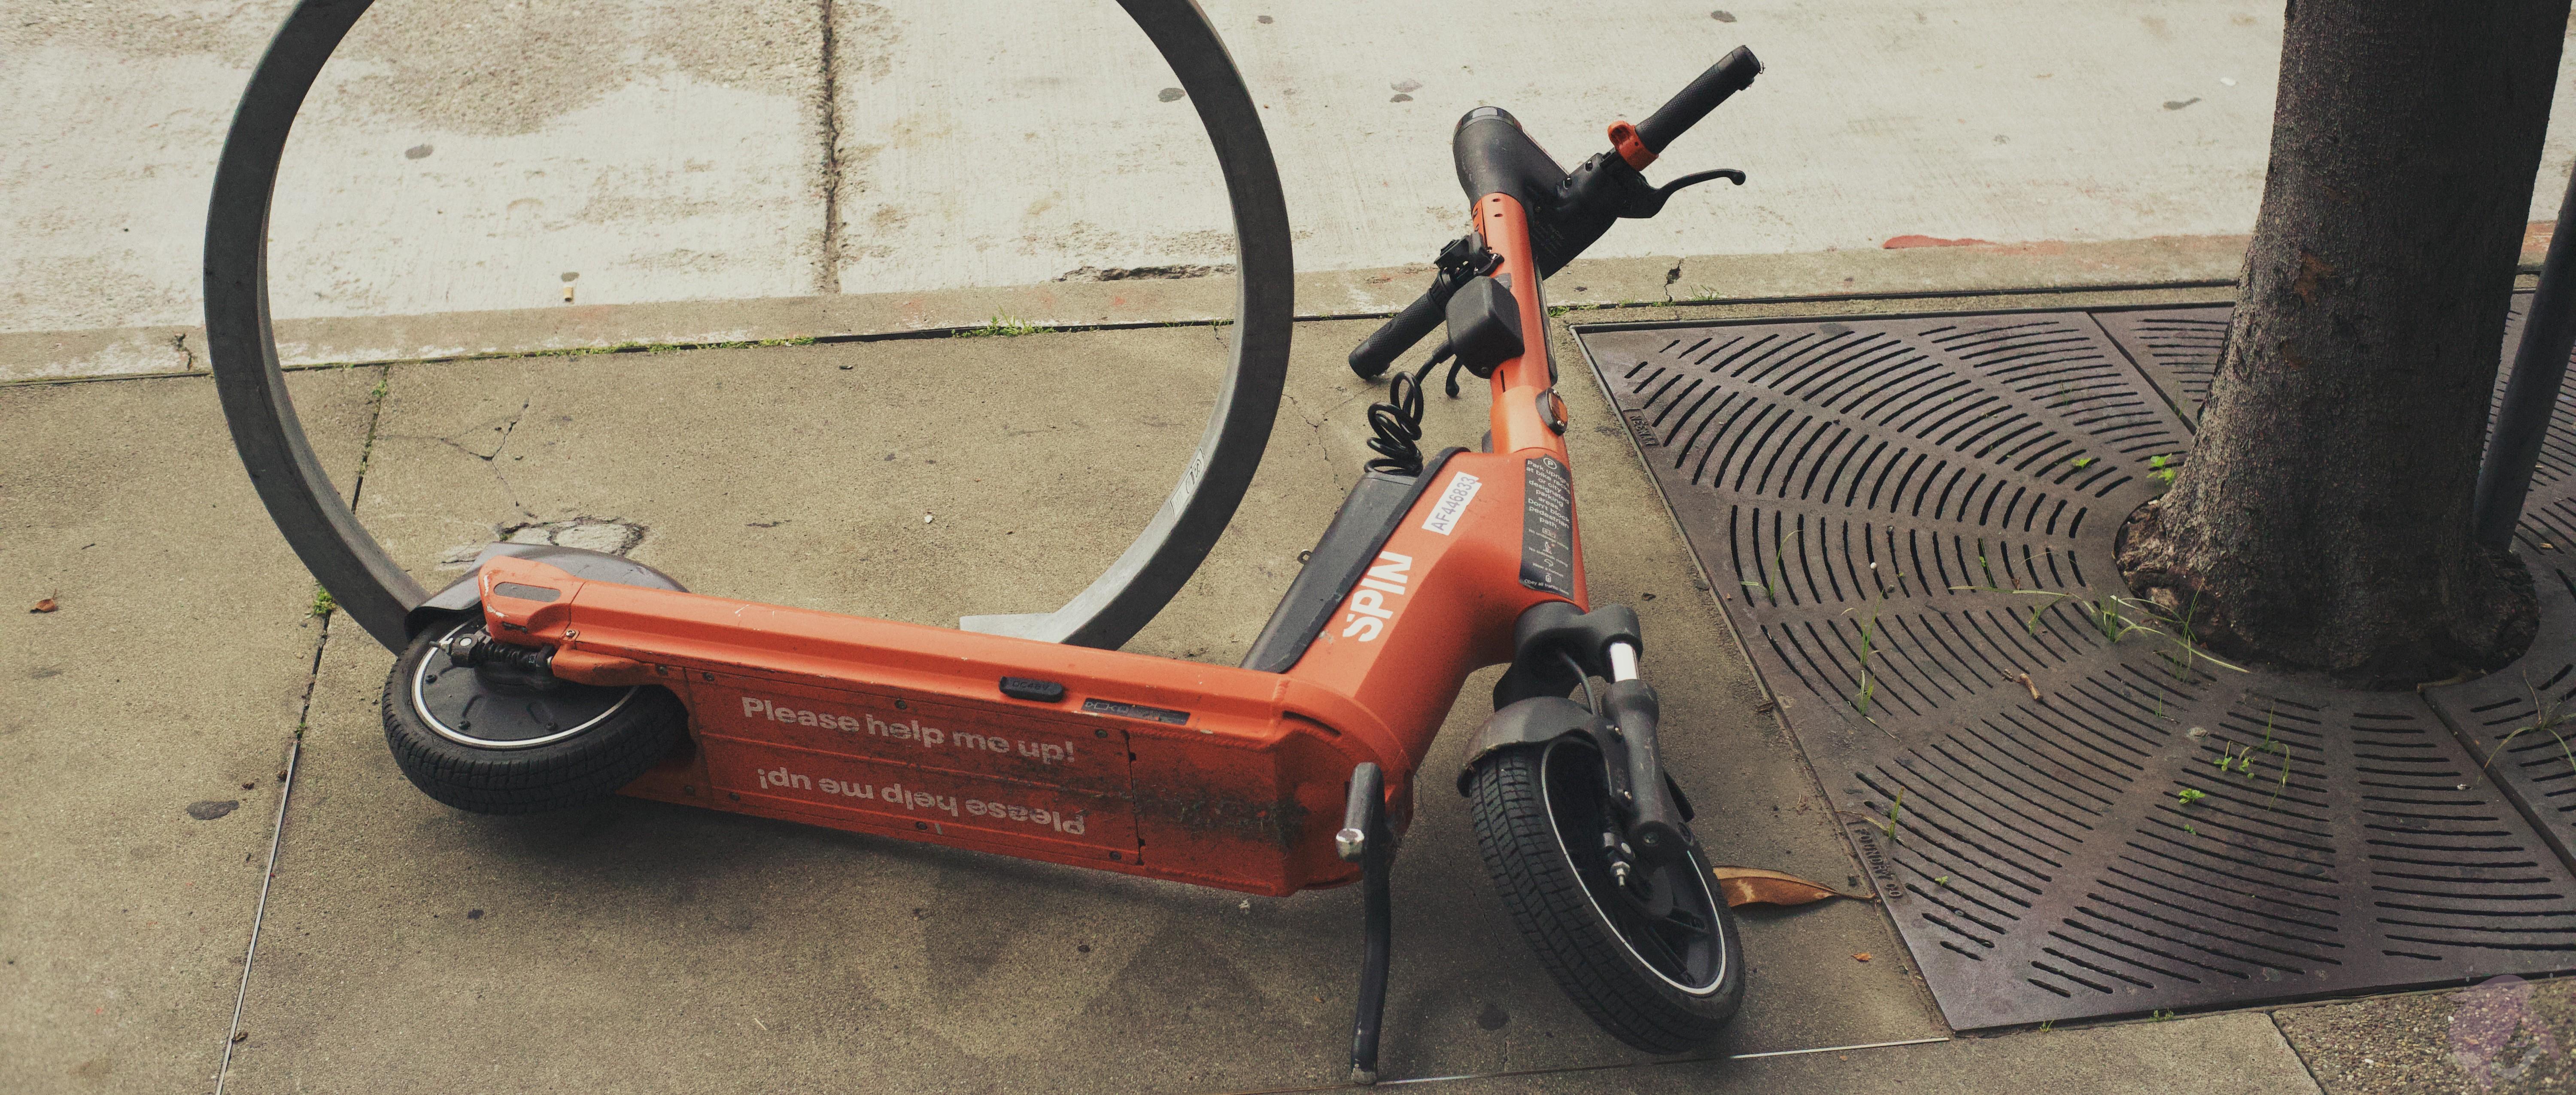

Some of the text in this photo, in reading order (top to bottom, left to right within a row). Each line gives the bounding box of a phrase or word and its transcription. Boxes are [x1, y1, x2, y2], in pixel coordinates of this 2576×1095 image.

[1528, 460, 1544, 471] Park
[1536, 470, 1551, 481] bike
[1529, 480, 1569, 505] designated
[1536, 489, 1564, 508] parking
[1548, 482, 1561, 493] city
[1431, 476, 1477, 532] AF446833
[1528, 498, 1570, 523] Don't block
[1538, 496, 1561, 511] areas.
[1529, 506, 1569, 529] pedestrian
[1540, 517, 1559, 530] path.
[1343, 551, 1413, 642] SPIN
[741, 696, 1075, 765] Please help me up!
[757, 766, 1085, 835] Please help me up!
[1854, 828, 1896, 880] FOUNDRY
